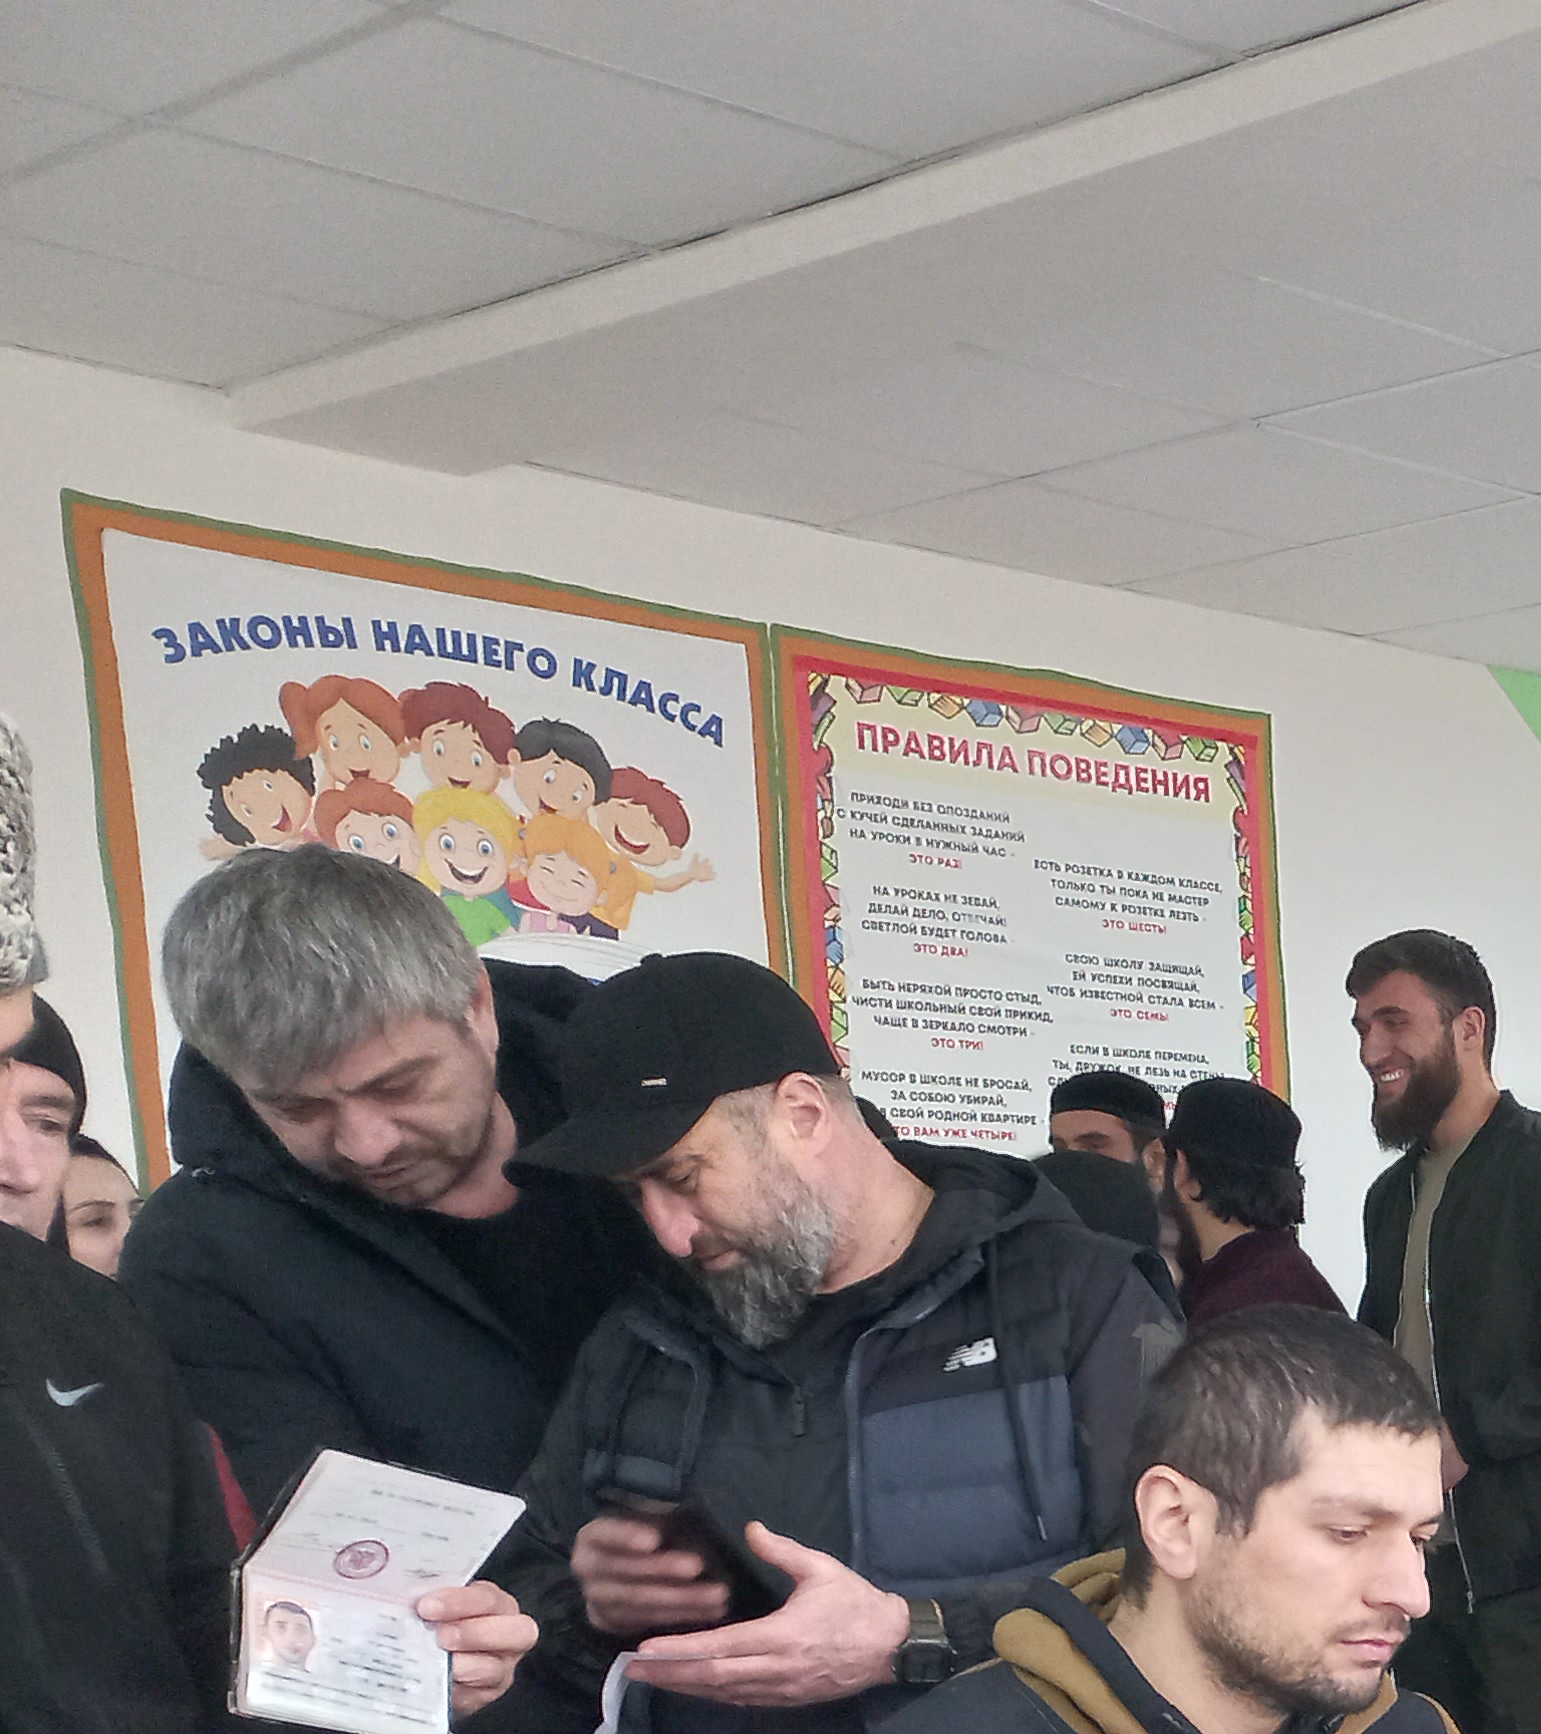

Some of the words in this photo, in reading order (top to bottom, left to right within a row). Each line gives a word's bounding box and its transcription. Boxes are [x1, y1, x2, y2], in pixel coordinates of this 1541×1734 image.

[151, 615, 356, 664] ЗАКОНЫ
[371, 619, 558, 680] НАШЕГО
[571, 657, 725, 748] КЛАССА
[856, 721, 1020, 775] ПРАВИЛА
[1027, 750, 1212, 803] ПОВЕДЕНИЯ
[851, 792, 909, 810] ПРИХОДИ
[913, 801, 933, 813] БЕЗ
[936, 804, 1010, 823] ОПОЗДАНИЙ
[836, 808, 846, 819] С
[850, 810, 888, 825] КУЧЕЙ
[892, 816, 966, 835] СДЕЛАННЫХ
[970, 826, 1025, 843] ЗАДАНИЙ
[850, 829, 867, 840] НА
[870, 831, 911, 846] УРОКИ
[926, 838, 979, 854] НУЖНЫЙ
[982, 846, 1006, 858] ЧАС
[909, 854, 933, 866] ЭТО
[1034, 859, 1062, 872] ЕСТЬ
[1065, 863, 1114, 879] РОЗЕТКА
[1128, 871, 1176, 887] КАЖДОМ
[1179, 878, 1223, 894] КЛАССЕ,
[873, 886, 890, 896] НА
[893, 887, 940, 902] УРОКАХ
[944, 894, 957, 904] НЕ
[1051, 879, 1095, 893] ТОЛЬКО
[1099, 885, 1115, 895] ТЫ
[1119, 887, 1149, 900] ПОКА
[1152, 891, 1165, 901] НЕ
[1168, 894, 1210, 907] МАСТЕР
[868, 903, 909, 917] ДЕЛАЙ
[912, 907, 949, 921] ДЕЛО,
[1055, 896, 1106, 911] САМОМУ
[1110, 903, 1118, 912] К
[1122, 904, 1165, 918] РОЗЕТКЕ
[1168, 910, 1199, 922] ЛЕЗТЬ
[861, 920, 917, 936] СВЕТЛОЙ
[920, 926, 957, 940] БУДЕТ
[960, 930, 1008, 944] ГОЛОВА
[1102, 919, 1125, 929] ЭТО
[1128, 922, 1167, 934] ШЕСТЬ!
[913, 943, 938, 955] ЭТО
[941, 946, 968, 958] ДВА!
[1065, 954, 1100, 966] СВОЮ
[1104, 958, 1144, 971] ШКОЛУ
[1072, 970, 1086, 981] ЕЙ
[1090, 973, 1133, 986] УСПЕХИ
[862, 979, 895, 992] БЫТЬ
[898, 982, 951, 997] НЕРЯХОЙ
[955, 988, 1003, 1002] ПРОСТО
[1005, 992, 1043, 1006] СТЫД,
[1046, 985, 1075, 997] ЧТОБ
[1080, 989, 1143, 1004] ИЗВЕСТНОЙ
[1148, 995, 1184, 1008] СТАЛА
[1188, 999, 1216, 1009] ВСЕМ
[852, 996, 893, 1009] ЧИСТИ
[896, 999, 966, 1015] ШКОЛЬНЫЙ
[969, 1006, 1002, 1018] СВОЙ
[1005, 1010, 1054, 1024] ПРИКИД,
[1110, 1008, 1132, 1019] ЭТО
[873, 1016, 908, 1029] ЧАЩЕ
[912, 1019, 919, 1028] В
[922, 1020, 975, 1033] ЗЕРКАЛО
[978, 1025, 1027, 1037] СМОТРИ
[931, 1038, 955, 1048] ЭТО
[959, 1041, 983, 1050] ТРИ!
[1070, 1045, 1099, 1055] ЕСЛИ
[1103, 1047, 1109, 1056] В
[1112, 1048, 1151, 1059] ШКОЛЕ
[861, 1071, 906, 1083] МУСОР
[910, 1074, 916, 1083] В
[919, 1075, 962, 1087] ШКОЛЕ
[965, 1078, 979, 1087] НЕ
[982, 1078, 1032, 1091] БРОСАЙ,
[1128, 1066, 1140, 1076] НЕ
[1144, 1067, 1170, 1077] ЛЕЗЬ
[1174, 1069, 1187, 1078] НА
[890, 1090, 907, 1100] ЗА
[910, 1092, 956, 1103] СОБОЮ
[959, 1095, 1007, 1107] УБИРАЙ,
[890, 1107, 924, 1119] СВОЙ
[928, 1109, 977, 1122] РОДНОЙ
[981, 1113, 1037, 1125] КВАРТИРЕ
[914, 1127, 939, 1137] ВАМ
[943, 1128, 967, 1138] УЖЕ
